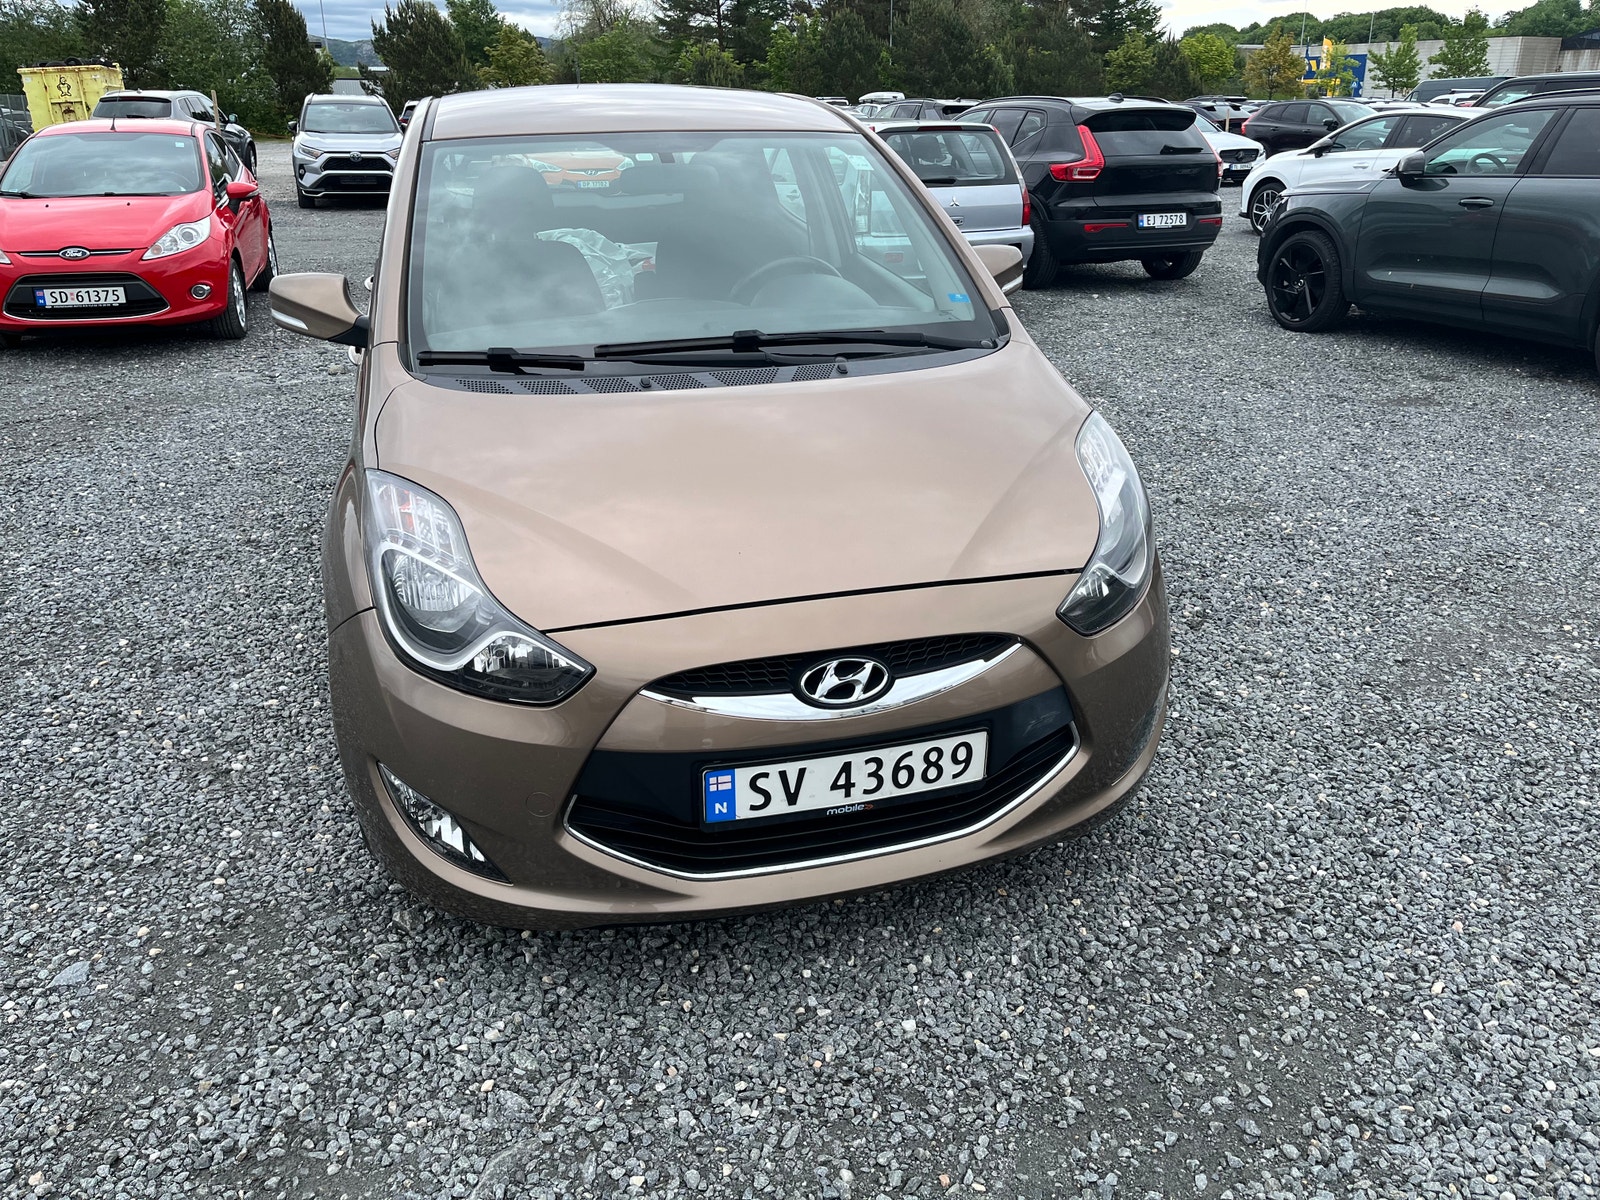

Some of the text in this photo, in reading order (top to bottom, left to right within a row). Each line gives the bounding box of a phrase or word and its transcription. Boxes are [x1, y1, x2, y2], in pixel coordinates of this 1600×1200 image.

[1147, 215, 1184, 226] EJ 72578
[50, 289, 120, 304] SD 61375
[748, 741, 973, 811] SV 43689
[714, 801, 728, 815] N
[826, 803, 865, 816] mobile
